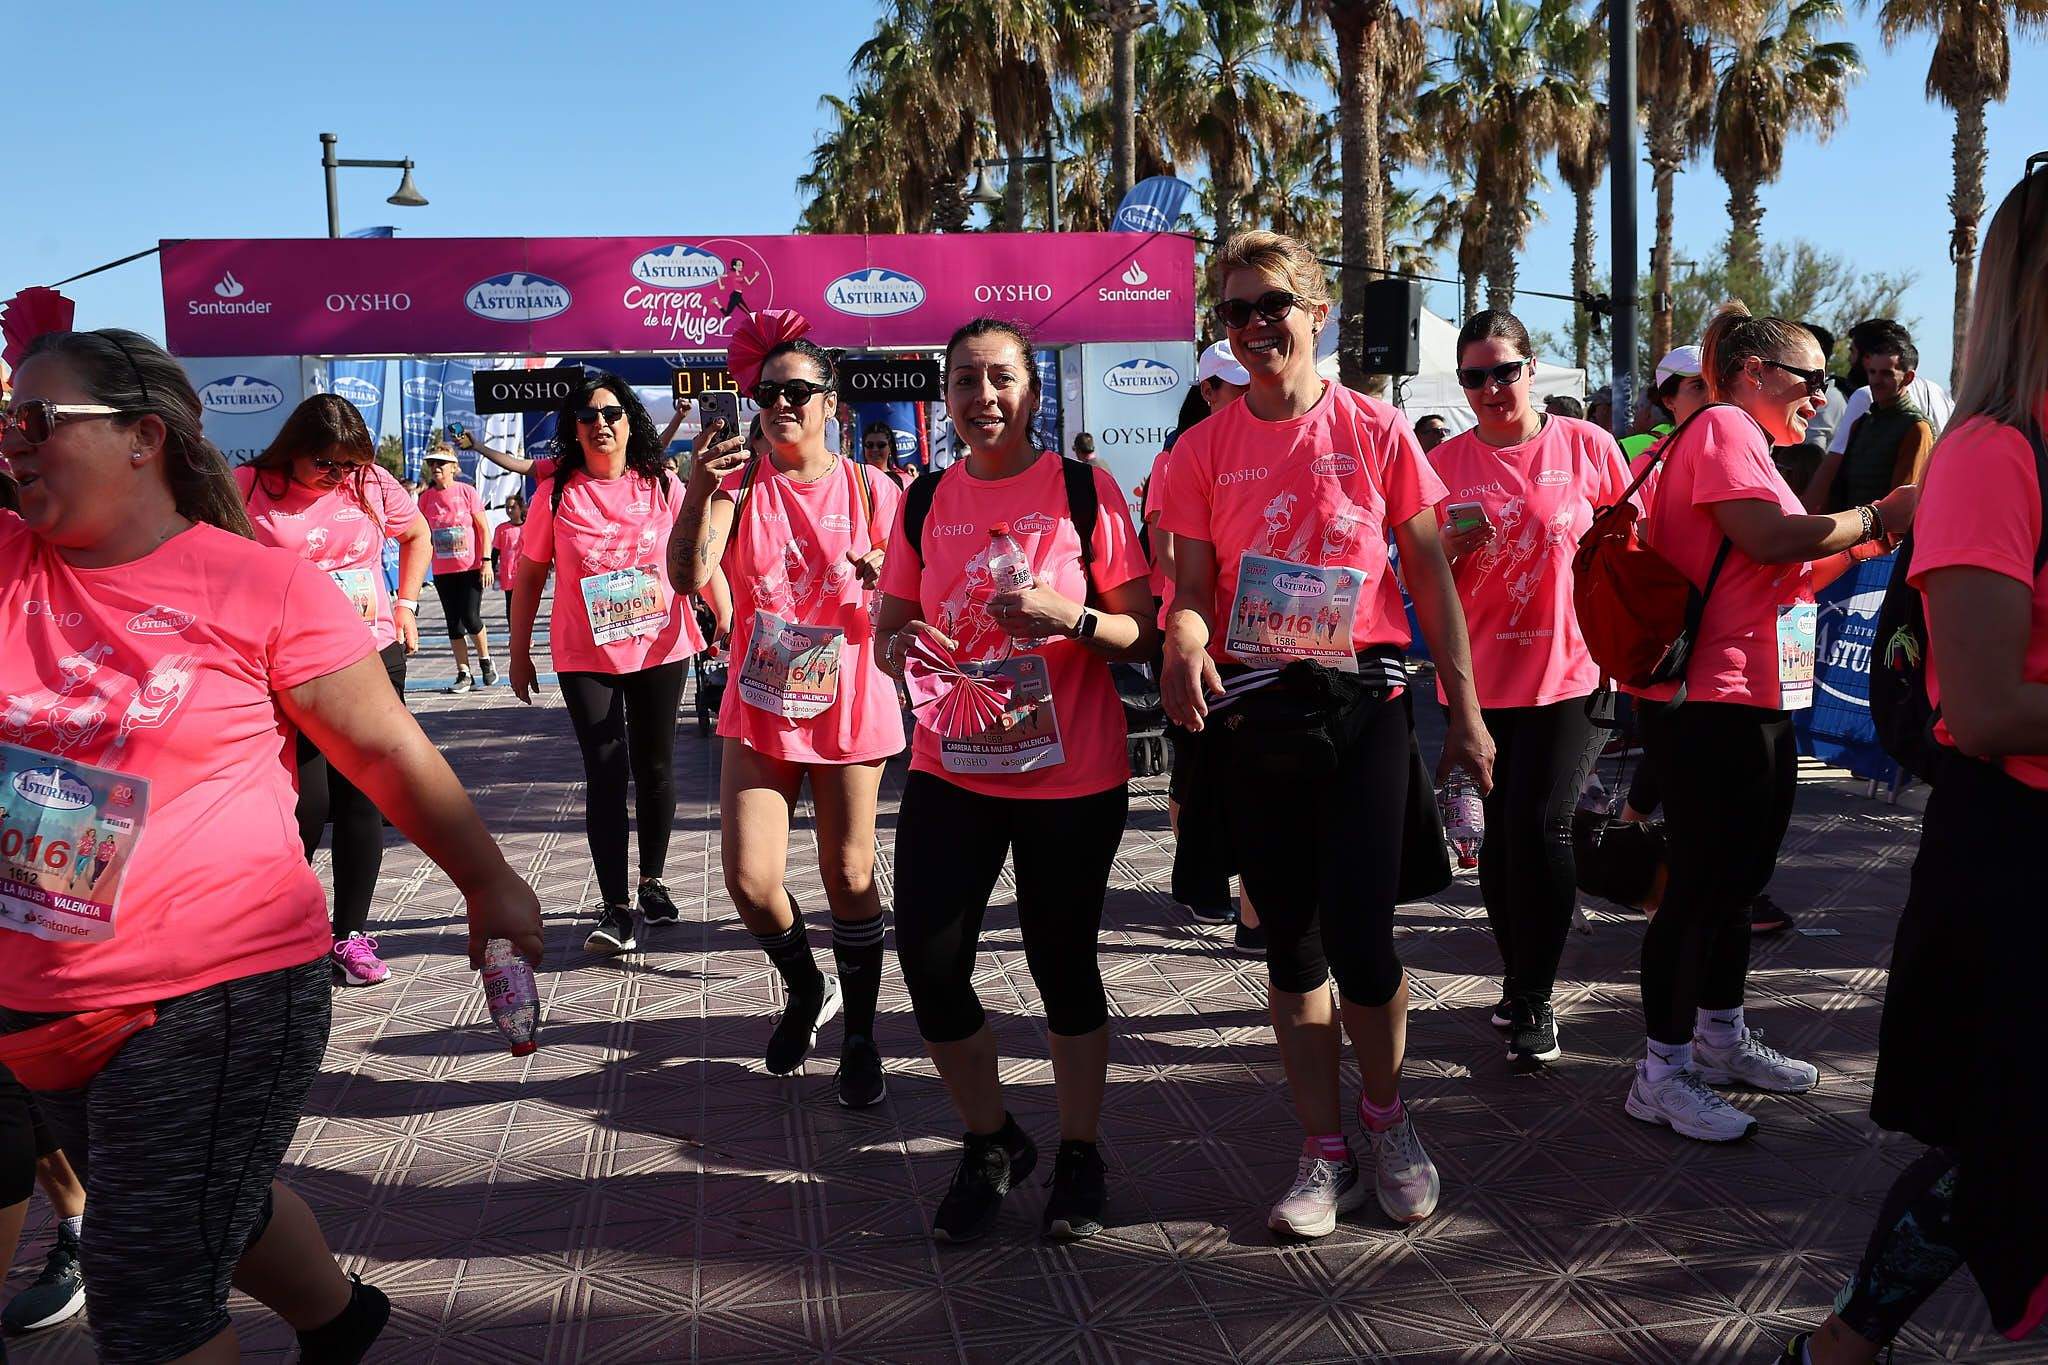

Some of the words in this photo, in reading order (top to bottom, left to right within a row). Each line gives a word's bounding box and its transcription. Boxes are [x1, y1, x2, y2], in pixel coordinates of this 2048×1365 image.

[639, 261, 719, 278] ASTURIANA
[473, 290, 563, 309] ASTURIANA
[623, 285, 703, 309] Carrera
[833, 286, 918, 304] ASTURIANA
[974, 284, 1052, 302] OYSHO
[1098, 287, 1172, 301] Santander
[188, 300, 272, 315] Santander
[326, 293, 411, 312] OYSHO
[643, 310, 659, 327] de
[661, 310, 673, 327] la
[670, 305, 732, 345] Mujer
[851, 372, 926, 390] OYSHO
[1109, 373, 1174, 387] ASTURIANA
[204, 391, 278, 406] ASTURIANA
[492, 382, 570, 400] OYSHO
[1218, 467, 1268, 486] OYSHO
[1460, 482, 1501, 498] OYSHO
[1274, 576, 1323, 594] ASTURIANA
[614, 598, 642, 613] 016
[1267, 612, 1313, 634] 016
[1232, 641, 1261, 653] CARRERA
[1312, 649, 1346, 657] VALENCIA
[1274, 636, 1297, 647] 1586
[1816, 622, 1872, 674] ASTU
[801, 693, 828, 701] VALENCIA
[946, 743, 972, 752] CARRERA
[981, 745, 990, 753] LA
[990, 745, 1013, 753] MUJER
[1018, 735, 1051, 749] VALENCIA
[18, 775, 88, 805] ASTURIANA
[114, 784, 131, 799] 20
[0, 828, 71, 868] 016
[9, 866, 38, 885] 1612
[3, 882, 15, 894] LA
[17, 885, 47, 902] MUJER
[54, 896, 100, 917] VALENCIA
[36, 914, 90, 936] Santander
